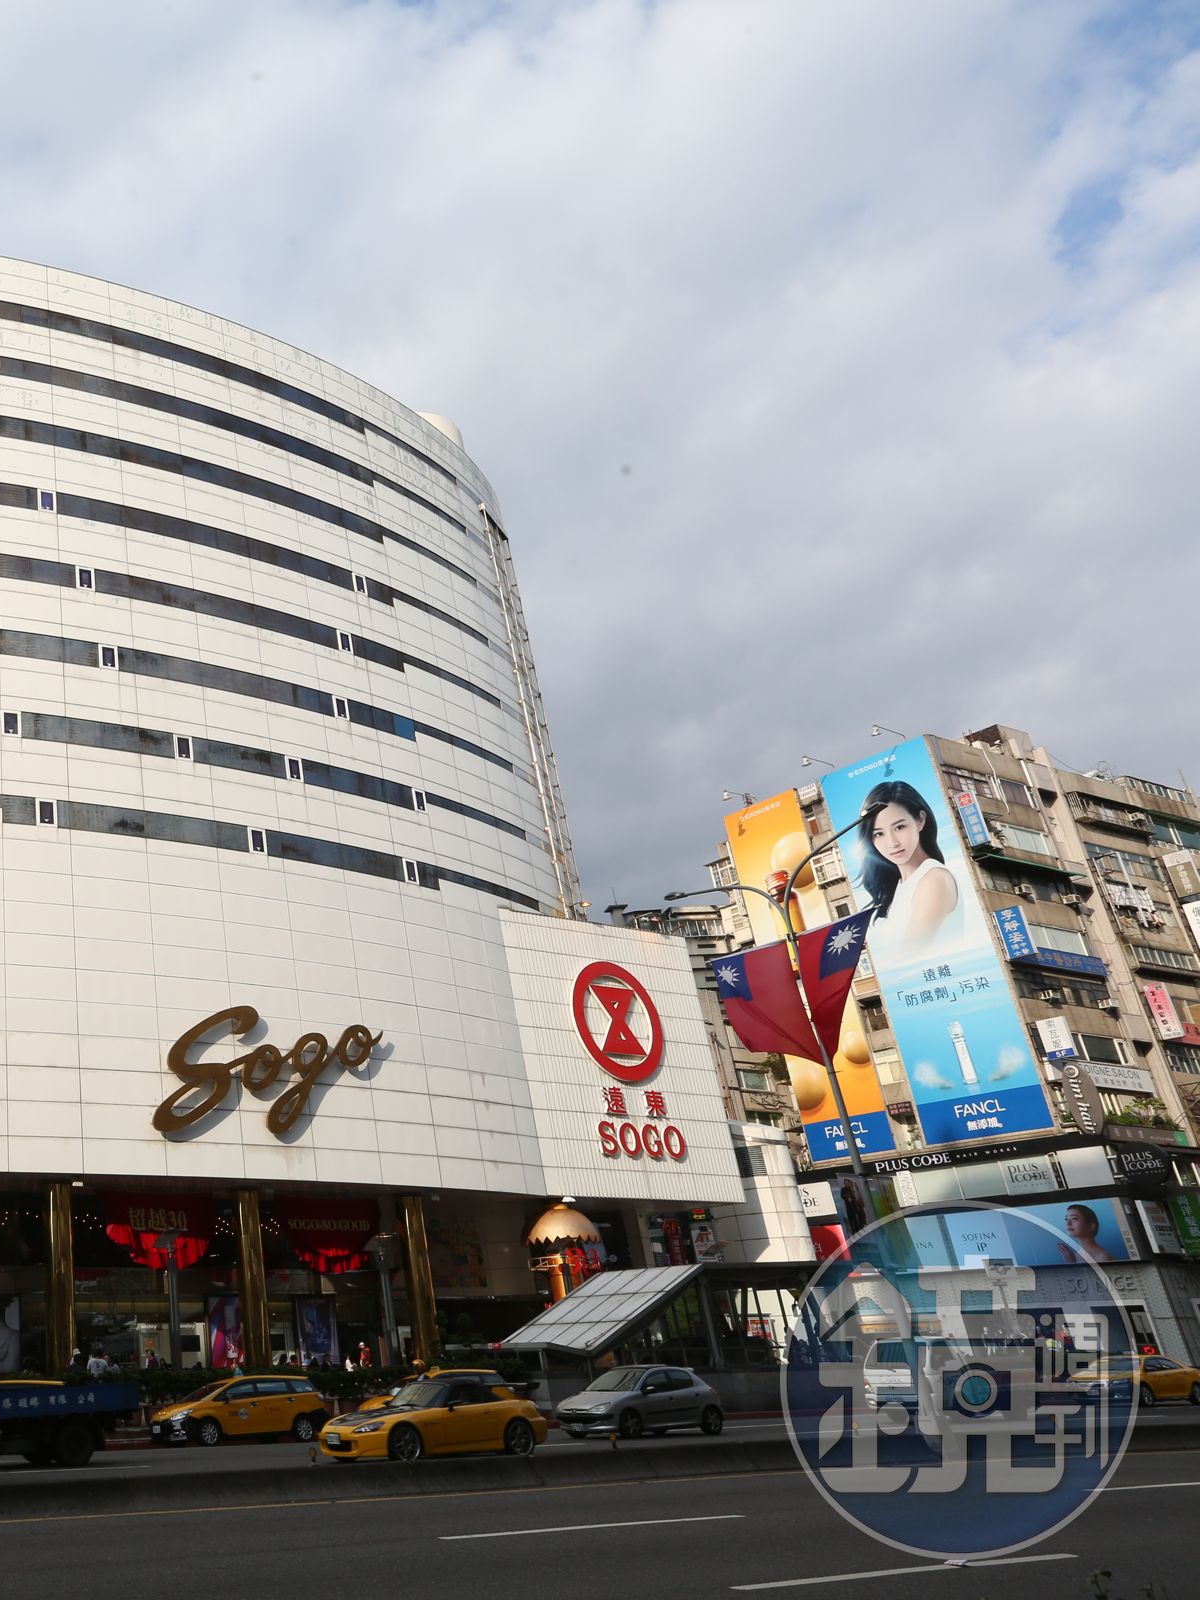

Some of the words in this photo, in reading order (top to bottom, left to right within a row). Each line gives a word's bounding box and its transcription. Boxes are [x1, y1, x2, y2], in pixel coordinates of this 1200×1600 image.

[922, 963, 952, 982] 遠離
[152, 1005, 384, 1136] Sogo
[602, 1086, 667, 1118] 遠東
[954, 1098, 1006, 1119] FANCL
[1076, 1101, 1097, 1135] hair
[597, 1120, 686, 1160] SOGO
[875, 1158, 910, 1173] PLUS
[911, 1153, 952, 1169] CODE
[1121, 1150, 1153, 1172] PLUS
[1128, 1158, 1164, 1171] CODE
[1007, 1162, 1039, 1183] PLUS
[1014, 1170, 1049, 1182] CODE
[961, 1232, 997, 1241] SOFINA
